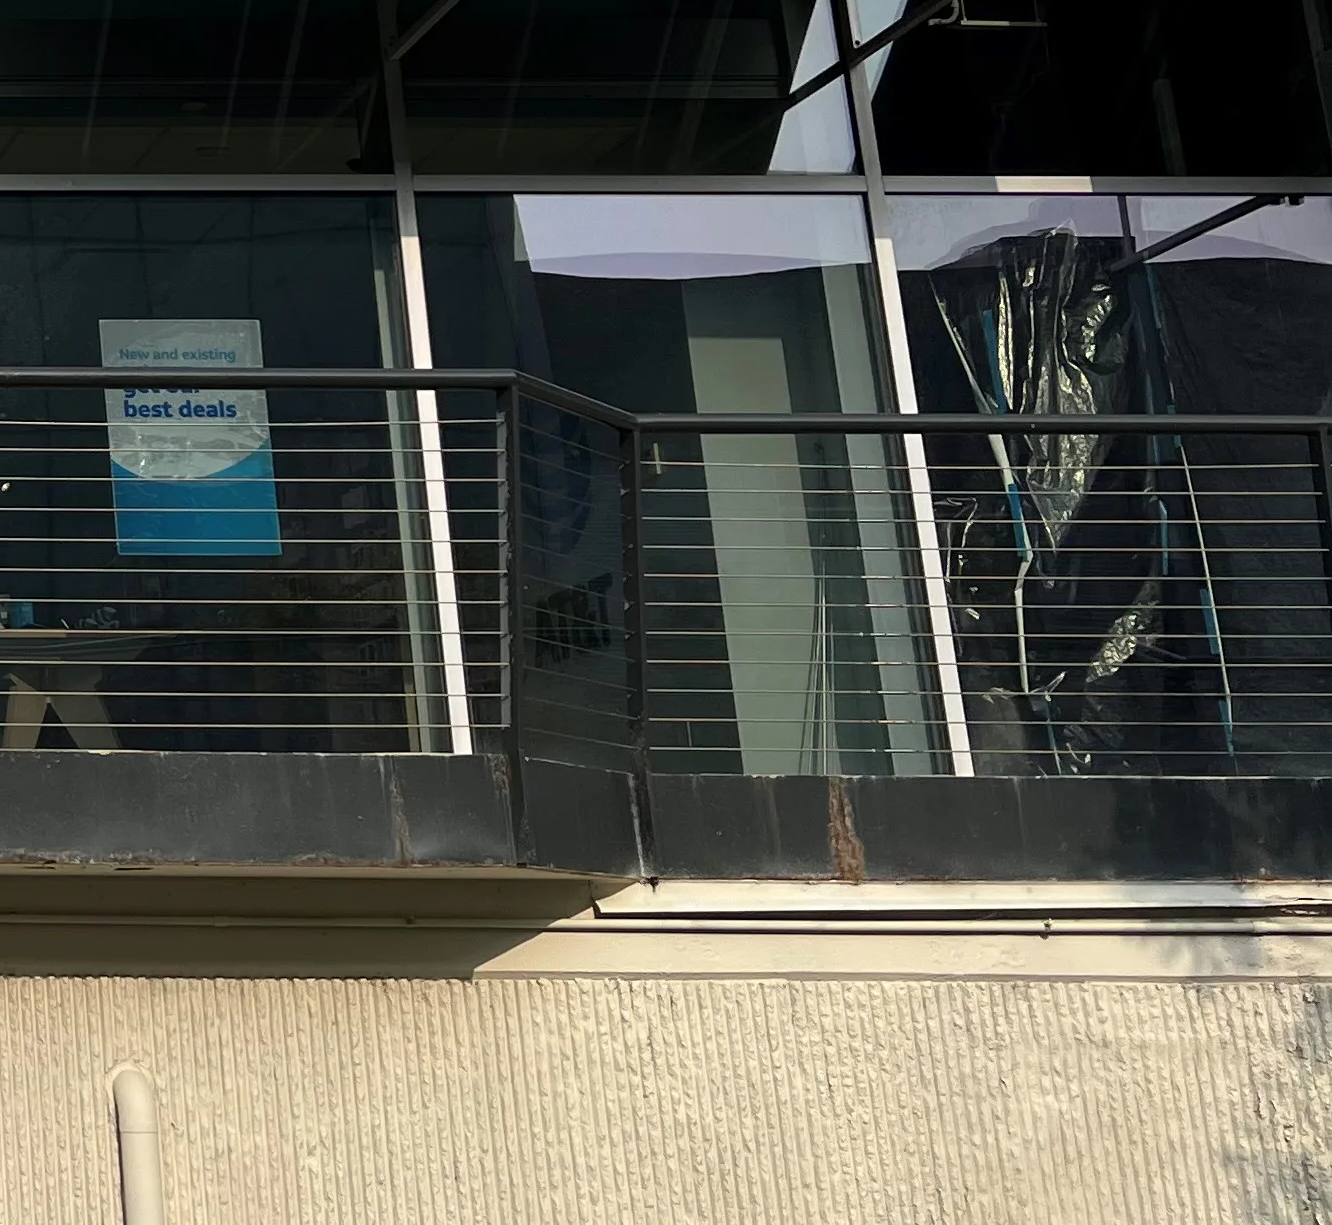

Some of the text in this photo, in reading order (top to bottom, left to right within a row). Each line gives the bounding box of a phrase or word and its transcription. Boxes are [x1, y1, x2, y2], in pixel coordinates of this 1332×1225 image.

[119, 348, 236, 363] New and existing
[124, 400, 237, 417] best deals
